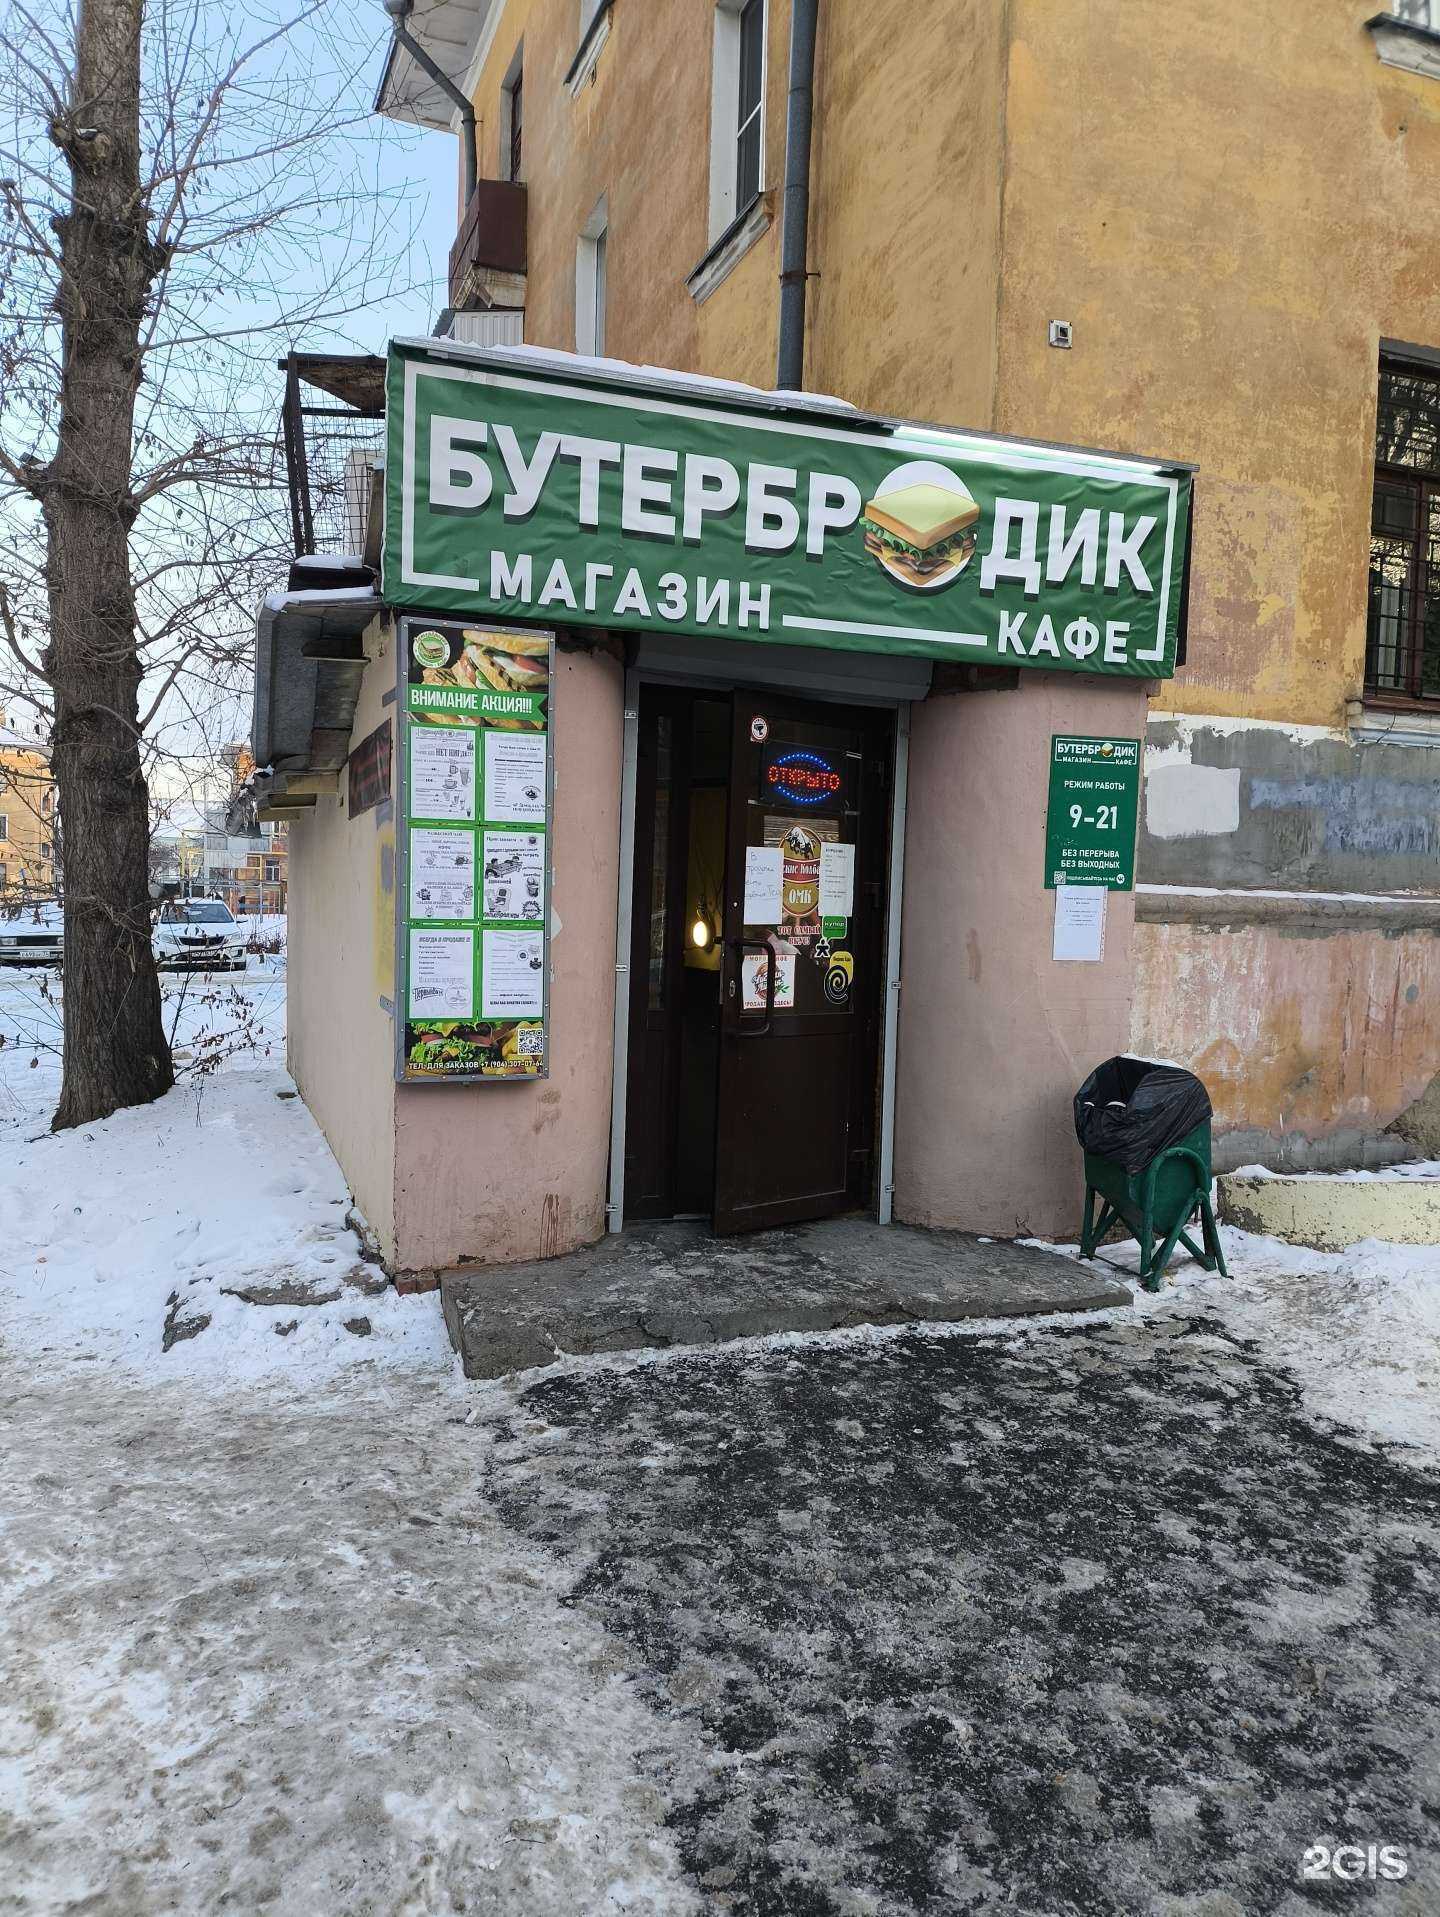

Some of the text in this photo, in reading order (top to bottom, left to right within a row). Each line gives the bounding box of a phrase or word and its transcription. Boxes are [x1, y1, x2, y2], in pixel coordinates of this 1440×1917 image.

[490, 550, 772, 631] МАГАЗИН
[997, 610, 1132, 664] КАФЕ
[411, 689, 533, 714] ВНИМАНИЕ АКЦИЯ!!!
[1115, 758, 1133, 766] КАФЕ
[768, 765, 841, 791] ОТКРЫТО
[1064, 780, 1125, 791] РЕЖИМ РАБОТЫ
[1069, 804, 1118, 830] 9-21
[1062, 849, 1120, 858] БЕЗ ПЕРЕРЫВА
[1061, 859, 1120, 869] БЕЗ ВЫХОДНЫХ
[788, 888, 812, 904] ОМК
[777, 925, 792, 935] ТОТ
[426, 1062, 444, 1070] ДЛЯ
[445, 1061, 479, 1069] ЗАКАЗОВ
